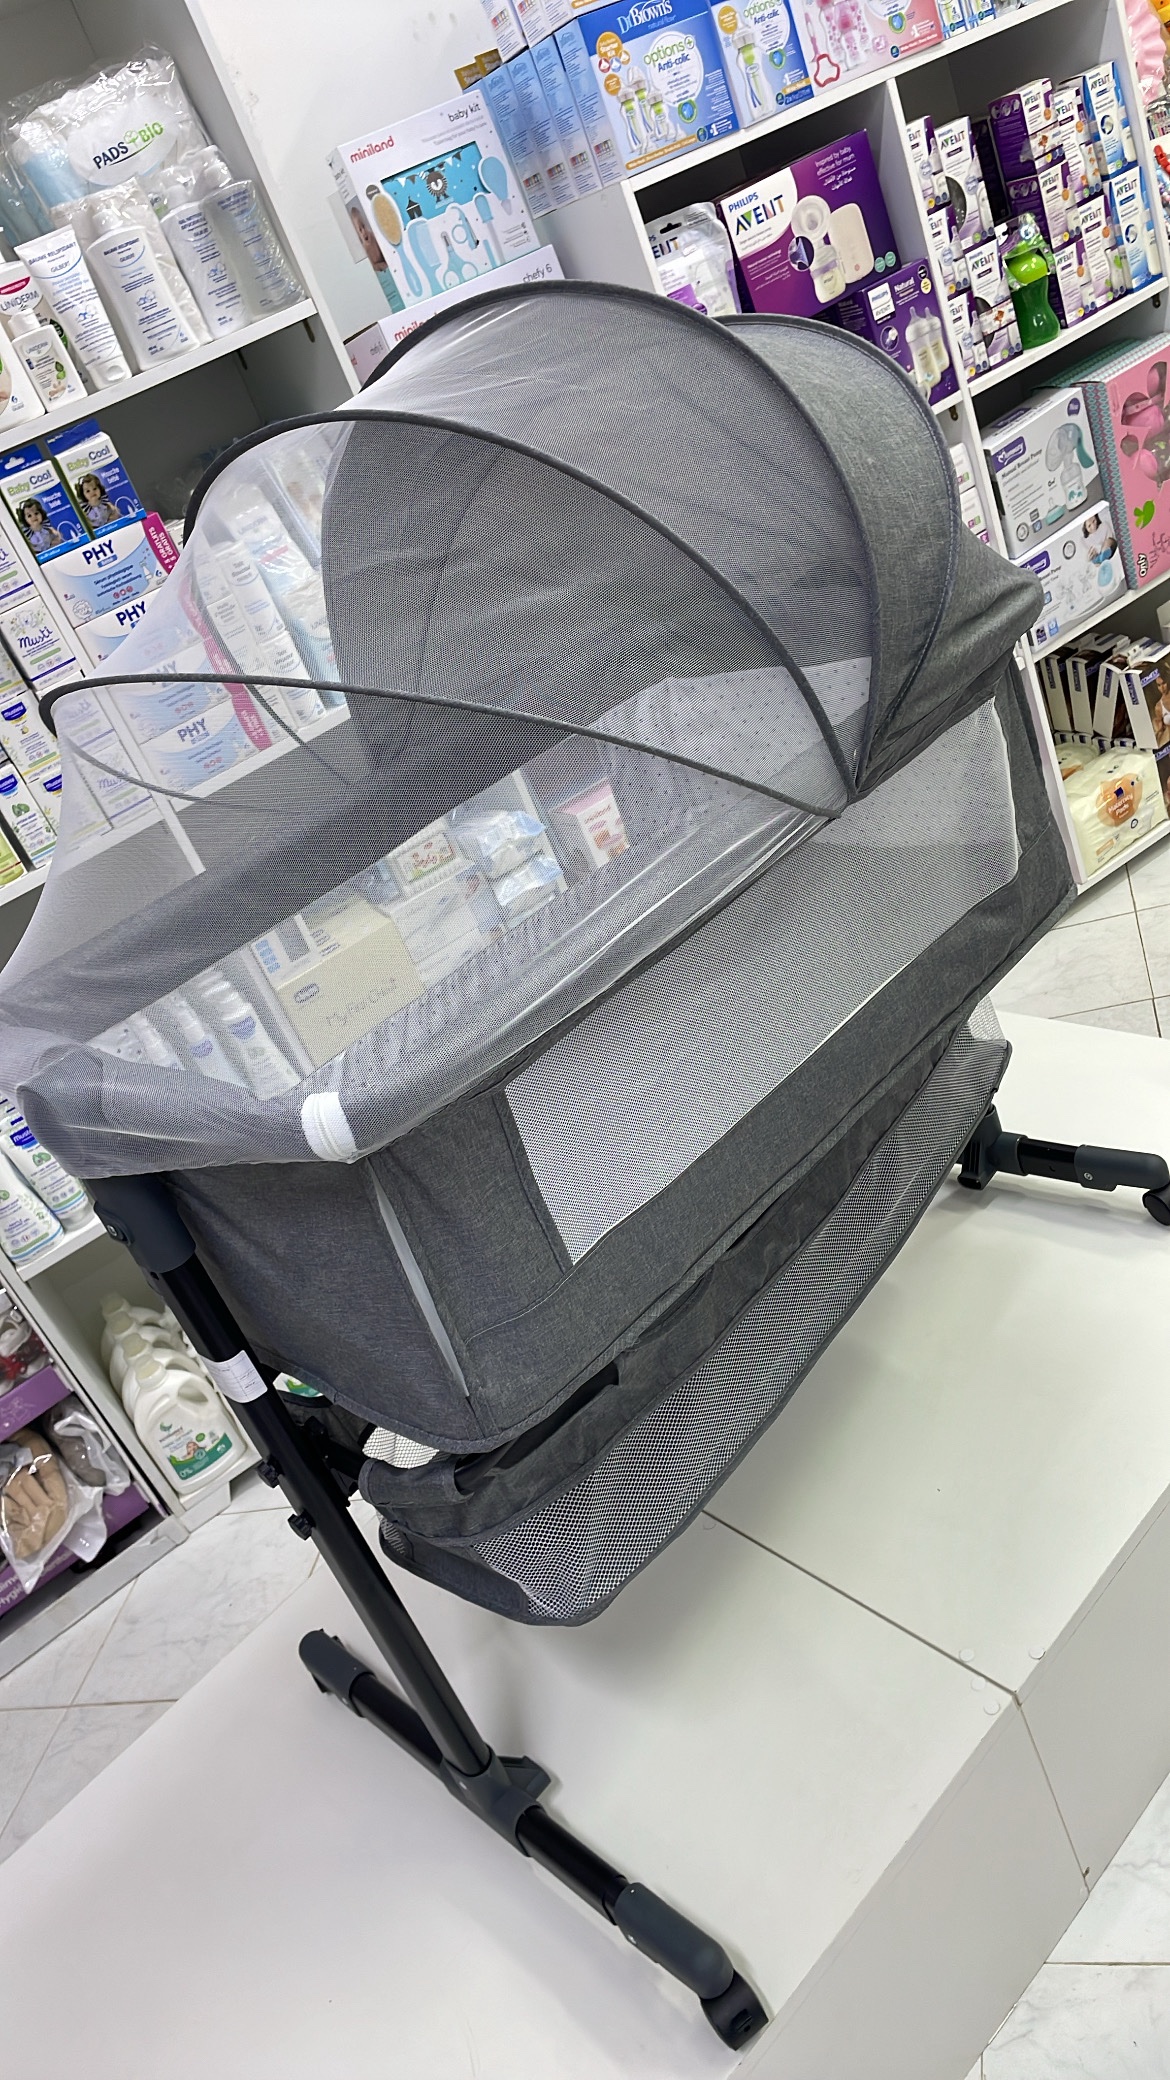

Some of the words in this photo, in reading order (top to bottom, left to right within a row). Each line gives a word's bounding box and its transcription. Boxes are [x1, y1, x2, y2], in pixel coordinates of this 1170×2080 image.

[644, 41, 684, 65] options
[658, 52, 690, 72] Anti-colic
[1091, 74, 1110, 90] AVENT
[448, 108, 469, 123] baby
[469, 103, 481, 114] kit
[909, 130, 921, 141] ENT
[941, 131, 965, 149] AVENT
[93, 142, 128, 169] PADS
[350, 136, 394, 163] miniland
[1042, 174, 1059, 187] AVENT
[1116, 179, 1137, 197] AVENT
[728, 192, 759, 213] PHILIPS
[736, 195, 785, 236] AVENT
[931, 219, 942, 230] ENT
[1081, 208, 1102, 225] AVENT
[652, 237, 679, 259] ENT
[1057, 252, 1074, 264] AVENT
[51, 261, 70, 273] GILBERT
[546, 263, 553, 274] 6
[971, 251, 995, 271] AVENT
[894, 277, 915, 292] Natural
[0, 291, 39, 311] UNIDERM
[67, 458, 89, 472] Baby
[88, 446, 110, 460] Cool
[1030, 449, 1042, 459] Pump
[7, 482, 30, 496] Baby
[30, 470, 52, 485] Cool
[82, 539, 115, 565] PHY
[148, 526, 168, 560] GRATUITS
[116, 601, 147, 626] PHY
[17, 626, 53, 649] Musti
[3, 705, 24, 720] Mustela
[177, 718, 206, 742] PHY
[1108, 793, 1133, 813] Maternity
[1115, 804, 1129, 816] Pads
